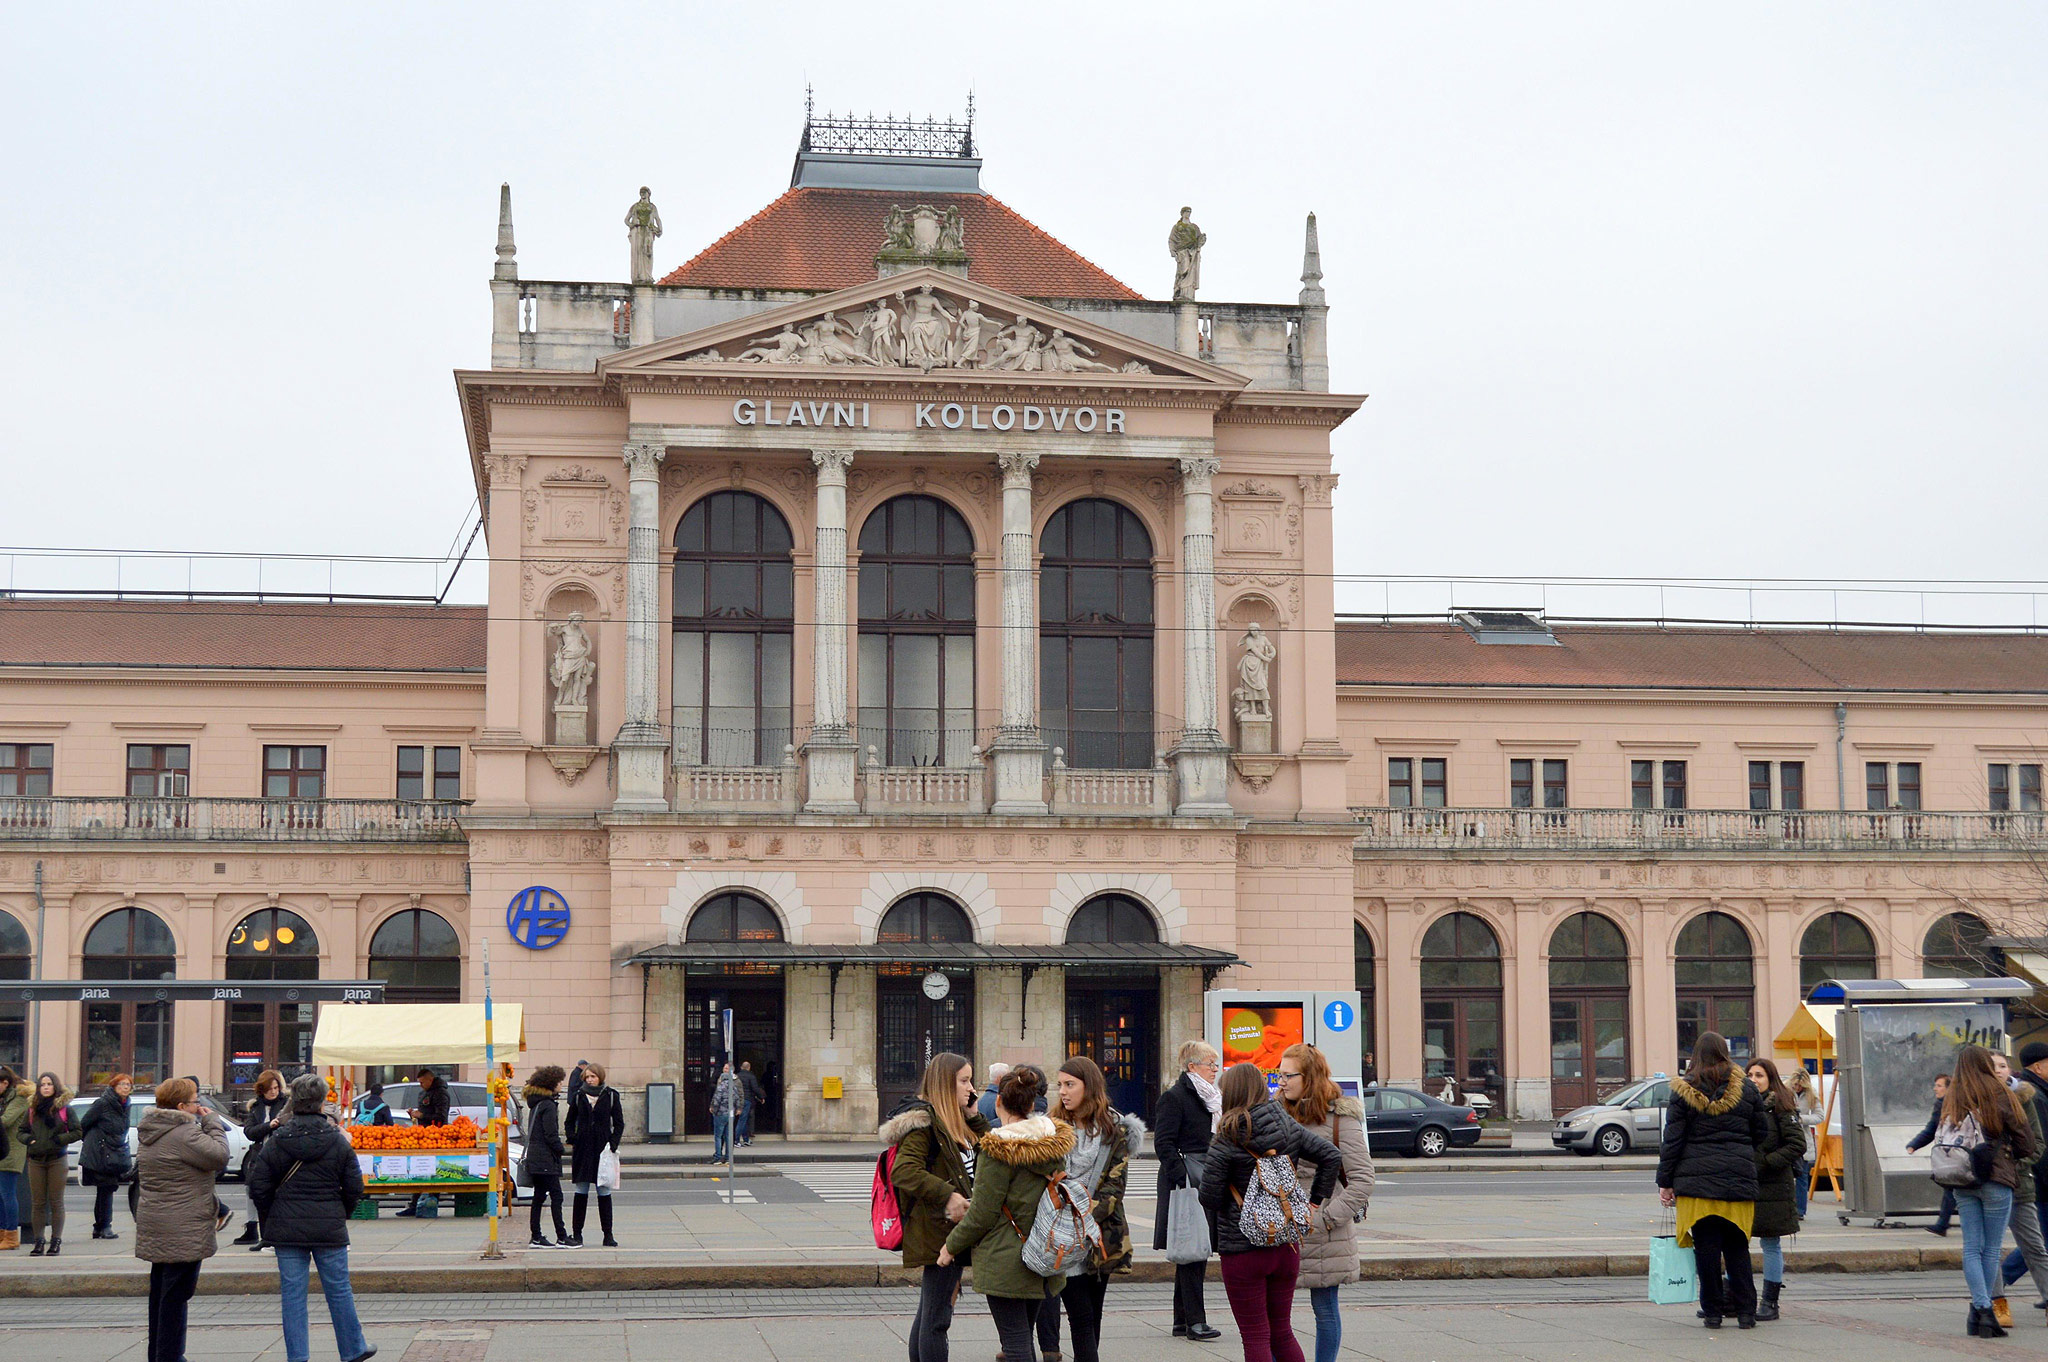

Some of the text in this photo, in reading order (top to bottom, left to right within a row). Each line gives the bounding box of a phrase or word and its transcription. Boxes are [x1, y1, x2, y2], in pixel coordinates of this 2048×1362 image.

[733, 398, 1126, 433] GLAVNI KOLODVOR
[1230, 1026, 1250, 1034] Isplata
[1238, 1031, 1260, 1039] minuta!
